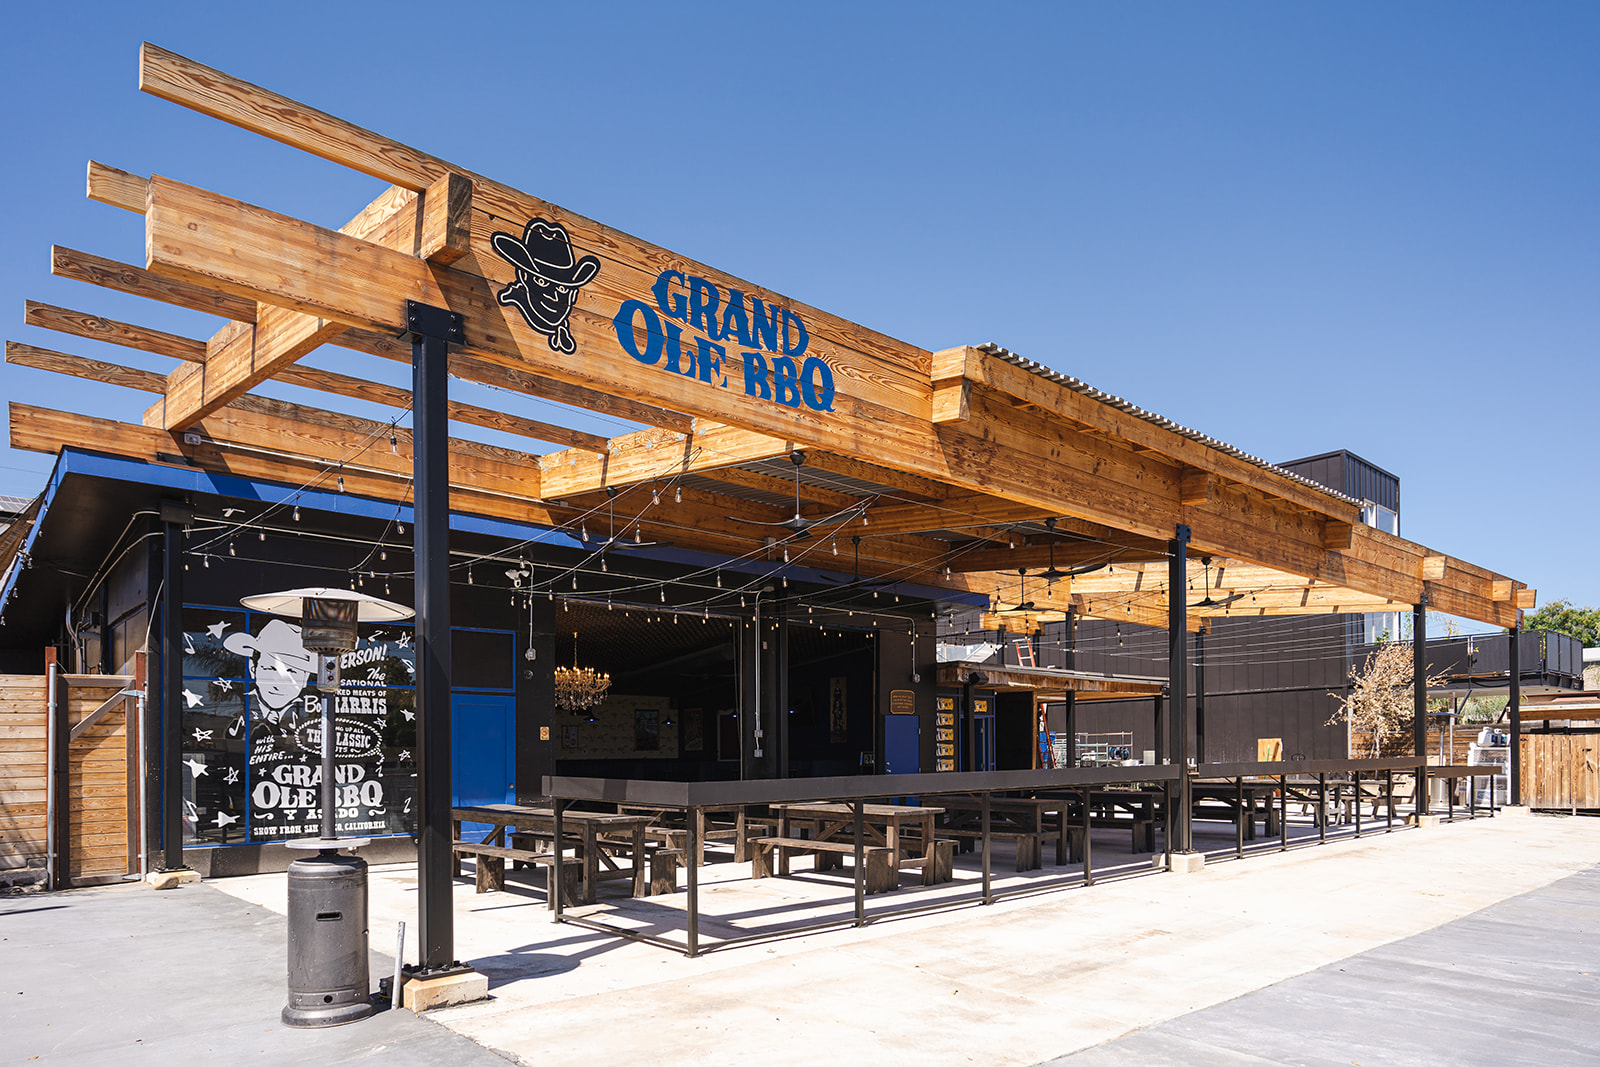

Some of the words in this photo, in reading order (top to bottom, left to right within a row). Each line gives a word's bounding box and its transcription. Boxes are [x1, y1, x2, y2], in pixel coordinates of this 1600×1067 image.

[651, 269, 809, 357] GRAND
[612, 299, 728, 388] OLE
[741, 352, 836, 413] BBQ
[340, 643, 388, 670] ERSON!
[367, 666, 387, 680] The
[340, 679, 387, 687] SATIONAL
[353, 690, 376, 698] MEATS
[256, 735, 275, 745] with
[306, 728, 321, 743] TH
[336, 732, 371, 749] LASSIC
[254, 744, 274, 755] HIS
[252, 781, 317, 809] OLE
[283, 809, 297, 820] Y
[254, 826, 277, 835] SHOW
[279, 825, 302, 834] FROM
[304, 824, 319, 833] SAN
[344, 821, 386, 832] CALIFORNIA
